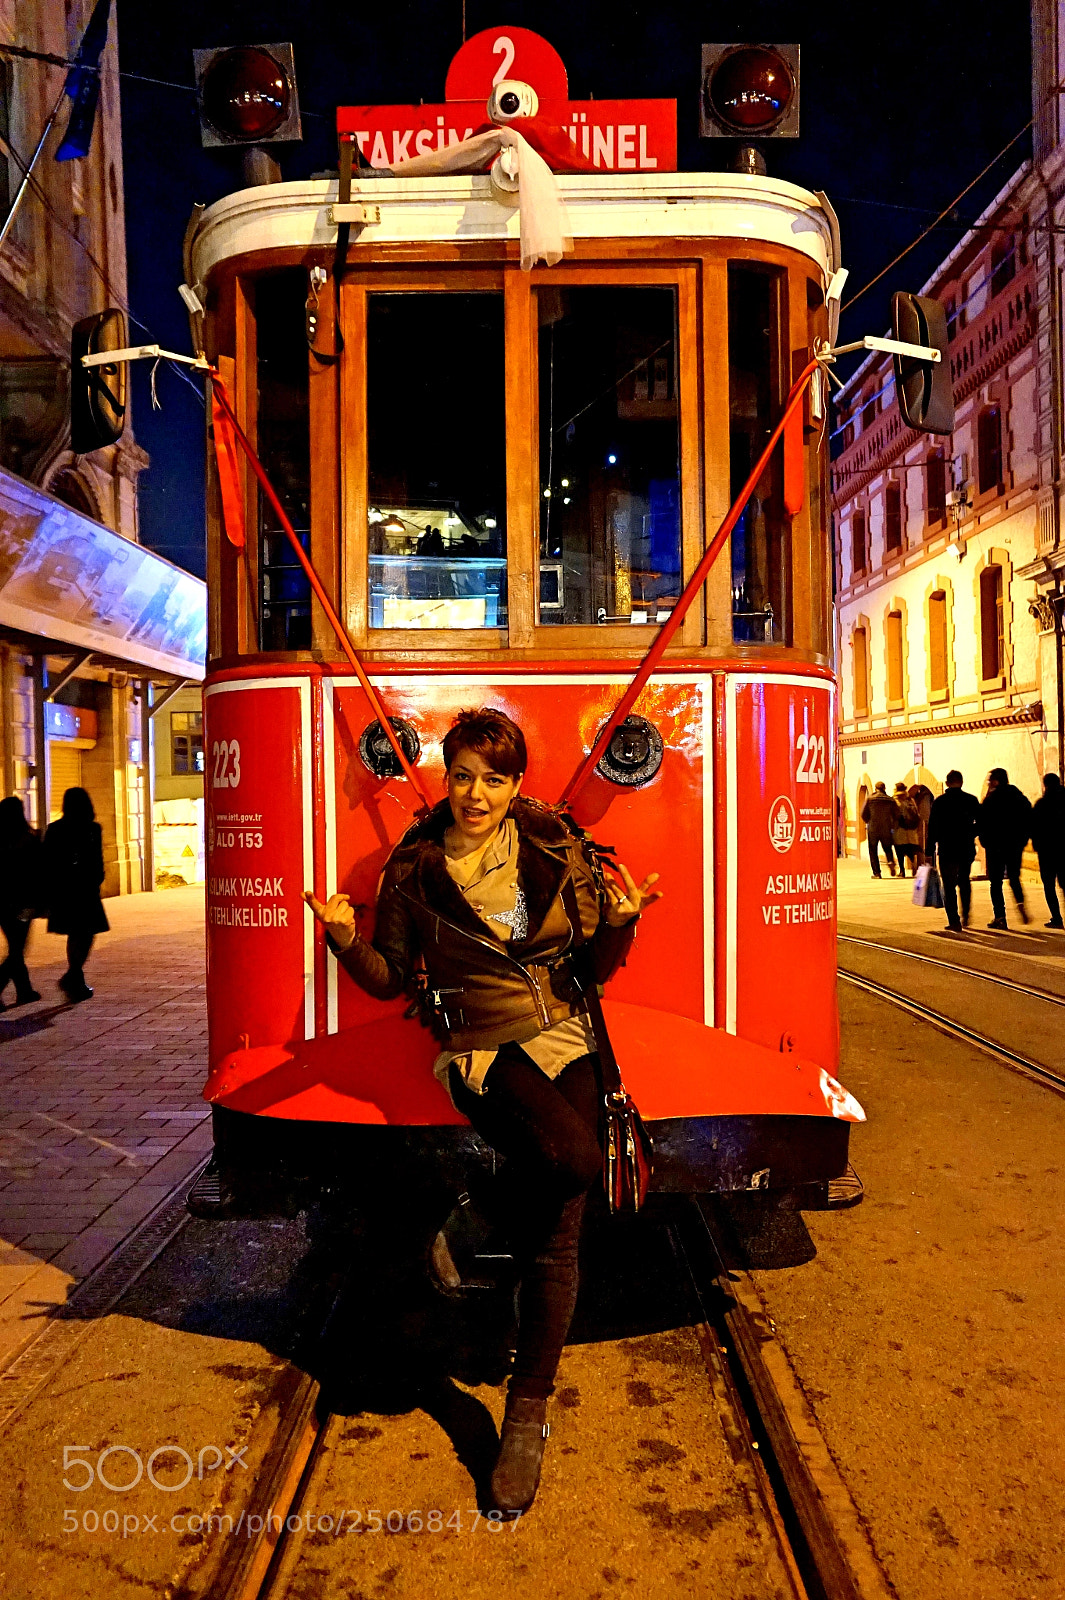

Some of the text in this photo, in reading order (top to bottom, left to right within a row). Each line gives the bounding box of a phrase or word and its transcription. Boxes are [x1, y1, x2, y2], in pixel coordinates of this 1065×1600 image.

[492, 36, 515, 88] 2
[561, 112, 658, 169] ÜNEL
[213, 739, 241, 788] 223
[796, 734, 825, 783] 223
[216, 832, 235, 848] ALO
[238, 832, 263, 848] 153
[799, 826, 821, 842] ALO
[209, 877, 284, 897] SILMAK YASAK
[765, 873, 819, 895] ASILMAK
[214, 903, 288, 927] TEHLİKELİDİR
[762, 905, 781, 925] VE
